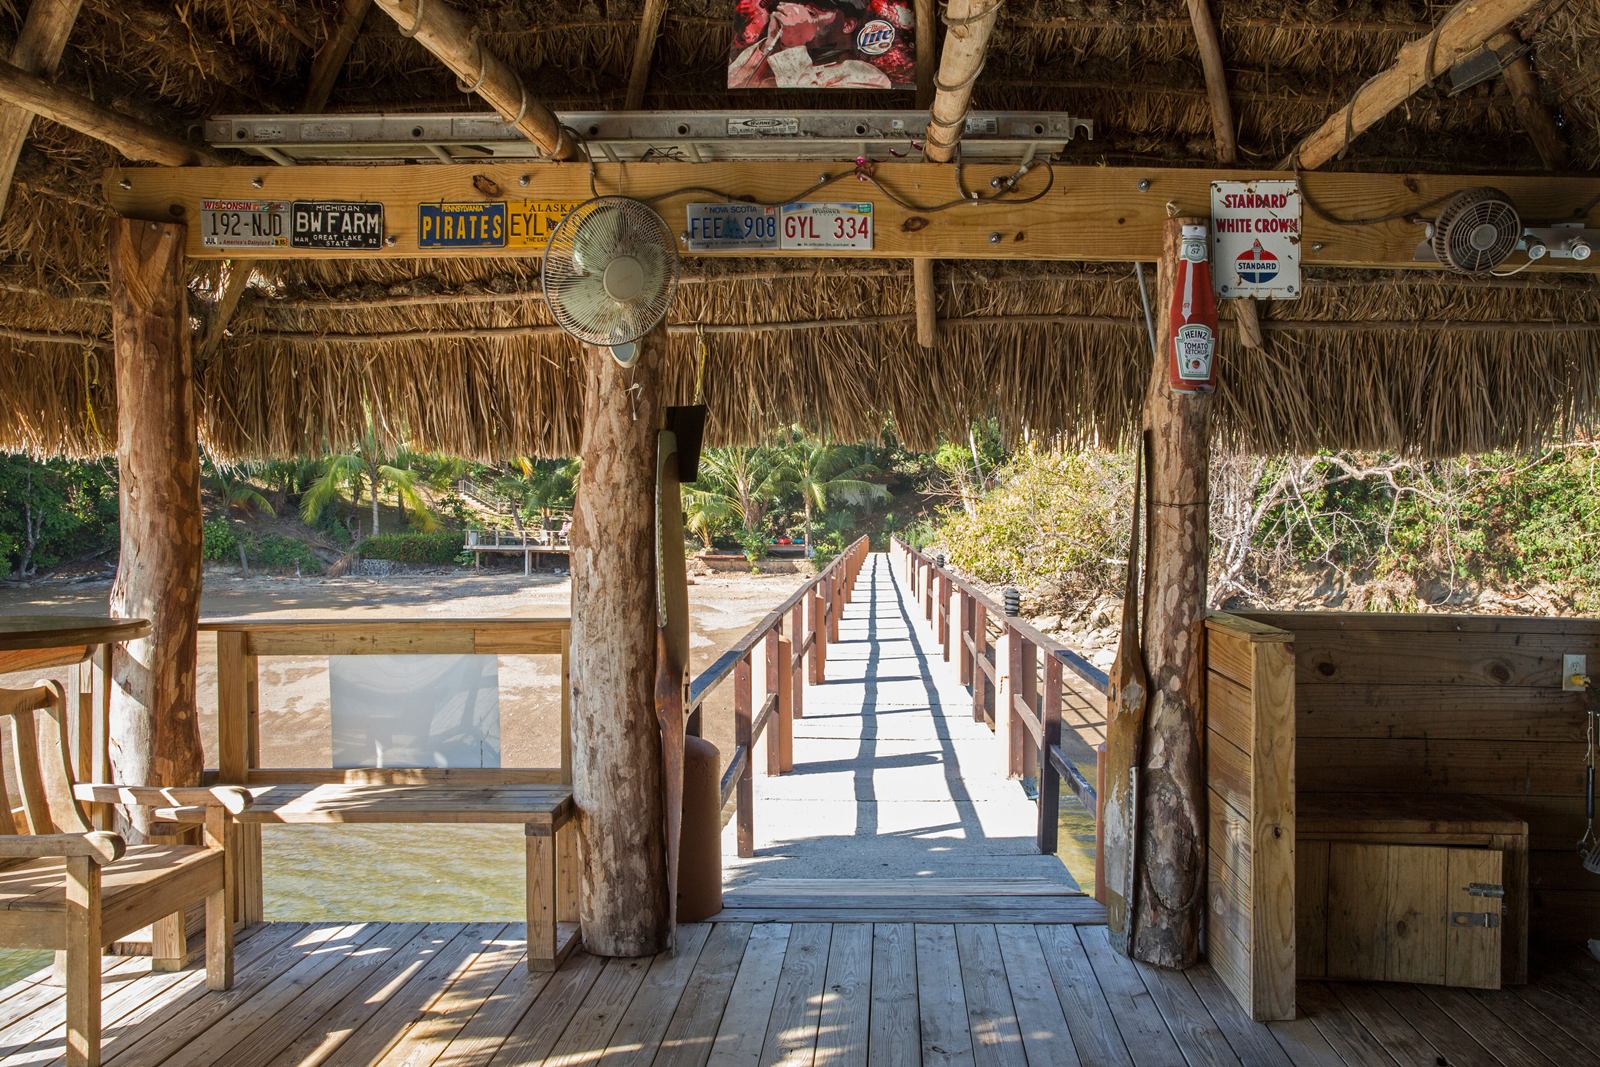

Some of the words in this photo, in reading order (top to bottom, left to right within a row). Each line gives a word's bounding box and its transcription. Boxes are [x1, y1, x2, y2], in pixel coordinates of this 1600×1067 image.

[861, 29, 893, 47] Lite
[203, 201, 252, 211] WISCONSIN
[731, 205, 758, 213] SCOTIA
[1224, 194, 1287, 209] STANDARD
[211, 212, 282, 237] 192-NJD
[422, 214, 502, 240] PIRATES
[511, 213, 544, 236] EYL
[691, 217, 723, 239] FEE
[744, 216, 776, 238] 908
[785, 215, 820, 239] GYL
[833, 216, 869, 239] 334
[1216, 218, 1252, 233] WHITE
[1254, 218, 1299, 233] CROWN
[343, 234, 362, 242] LAKE
[1238, 262, 1277, 270] STANDARD
[1184, 329, 1208, 340] HEINZ
